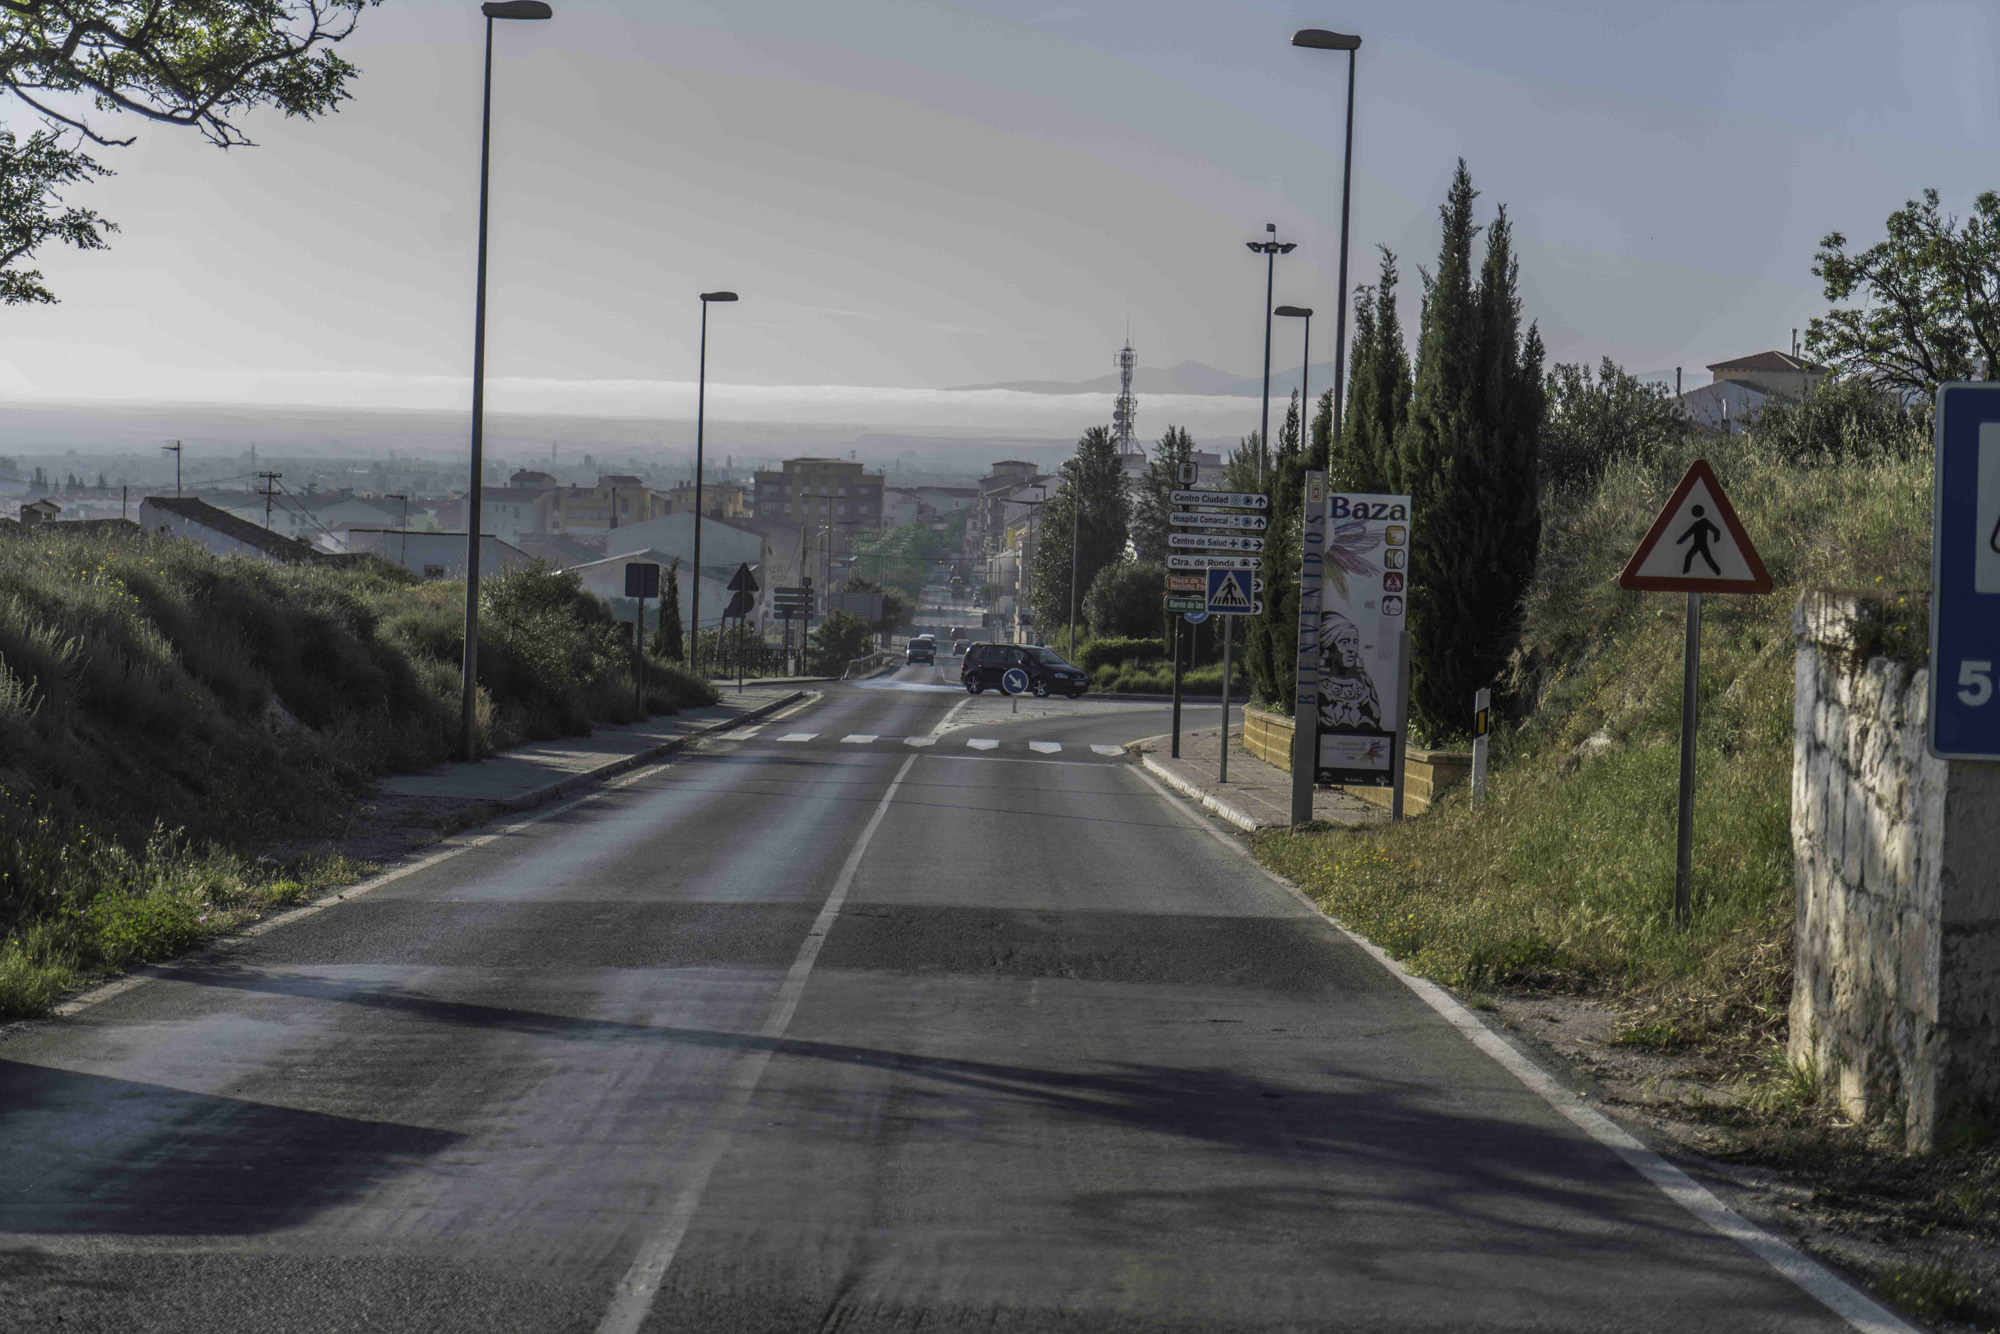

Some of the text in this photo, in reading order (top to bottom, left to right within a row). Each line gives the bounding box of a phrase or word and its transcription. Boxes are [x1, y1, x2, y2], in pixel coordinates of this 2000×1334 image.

[1174, 493, 1229, 504] Centro Ciudad
[1328, 496, 1409, 521] Baza
[1173, 515, 1228, 525] Hospital Comarcal
[1172, 536, 1228, 547] Centro de Salud
[1171, 558, 1235, 567] Ctra. de Ronda
[1169, 600, 1204, 610] Barrio de las
[1297, 514, 1325, 705] BIENVENIDOS
[1957, 660, 2000, 706] 5
